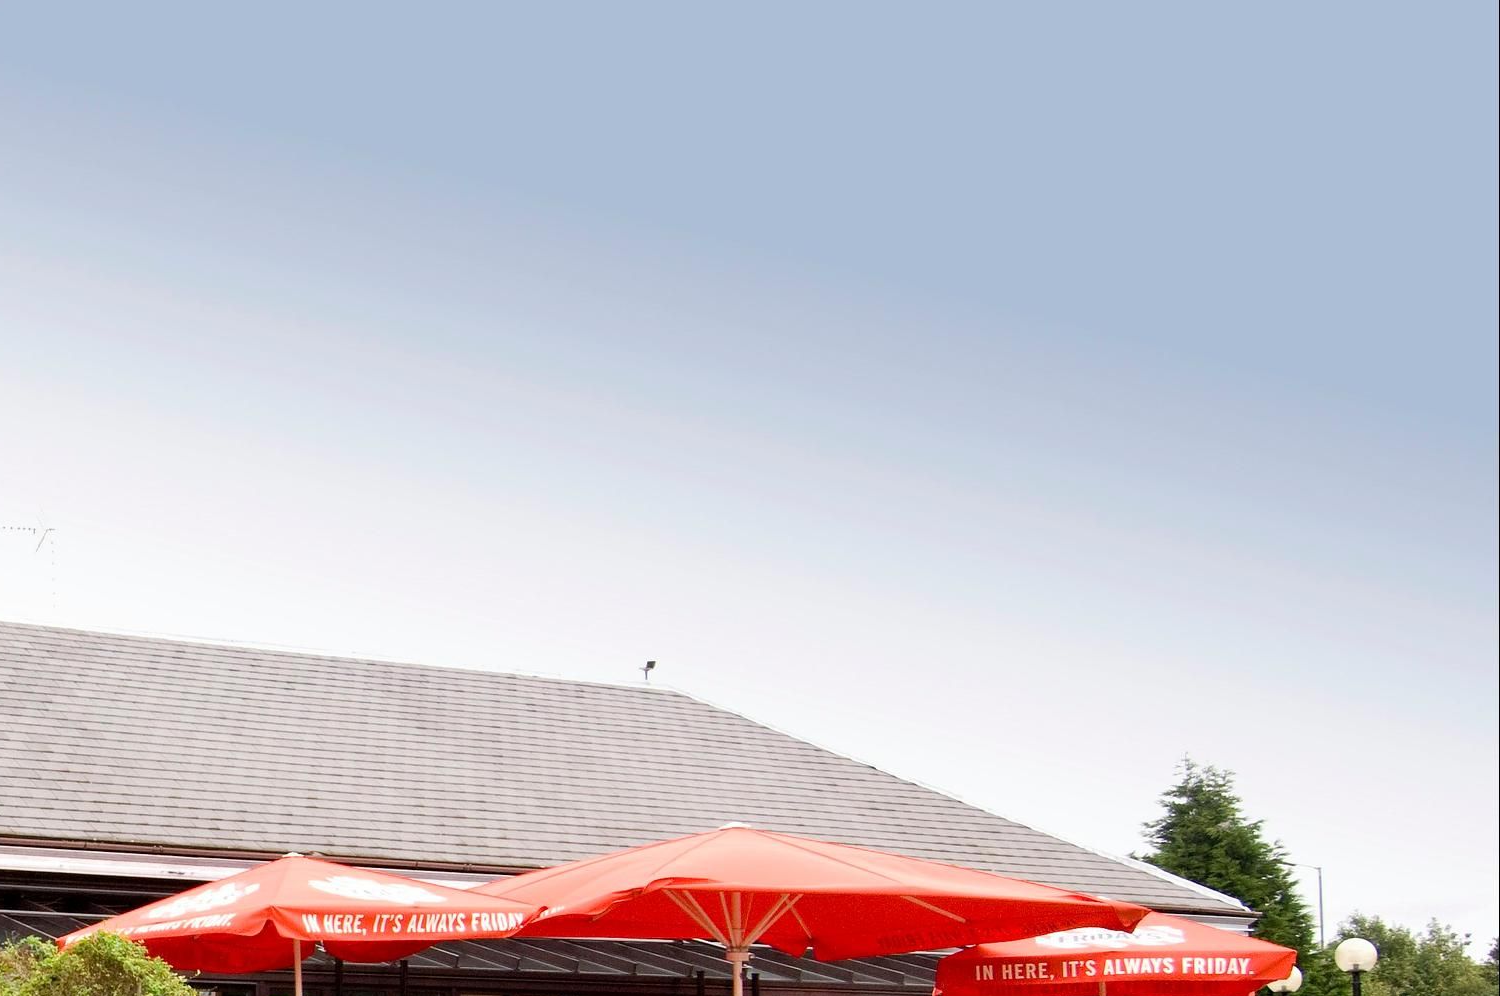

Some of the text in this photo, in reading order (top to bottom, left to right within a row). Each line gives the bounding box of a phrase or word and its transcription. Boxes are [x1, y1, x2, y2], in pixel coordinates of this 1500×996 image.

[301, 913, 318, 934] IN
[323, 913, 367, 936] HERE,
[372, 913, 405, 934] IT'S
[407, 912, 467, 933] ALWAYS
[975, 957, 1255, 982] IN HERE, IT'S ALWAYS FRIDAY.
